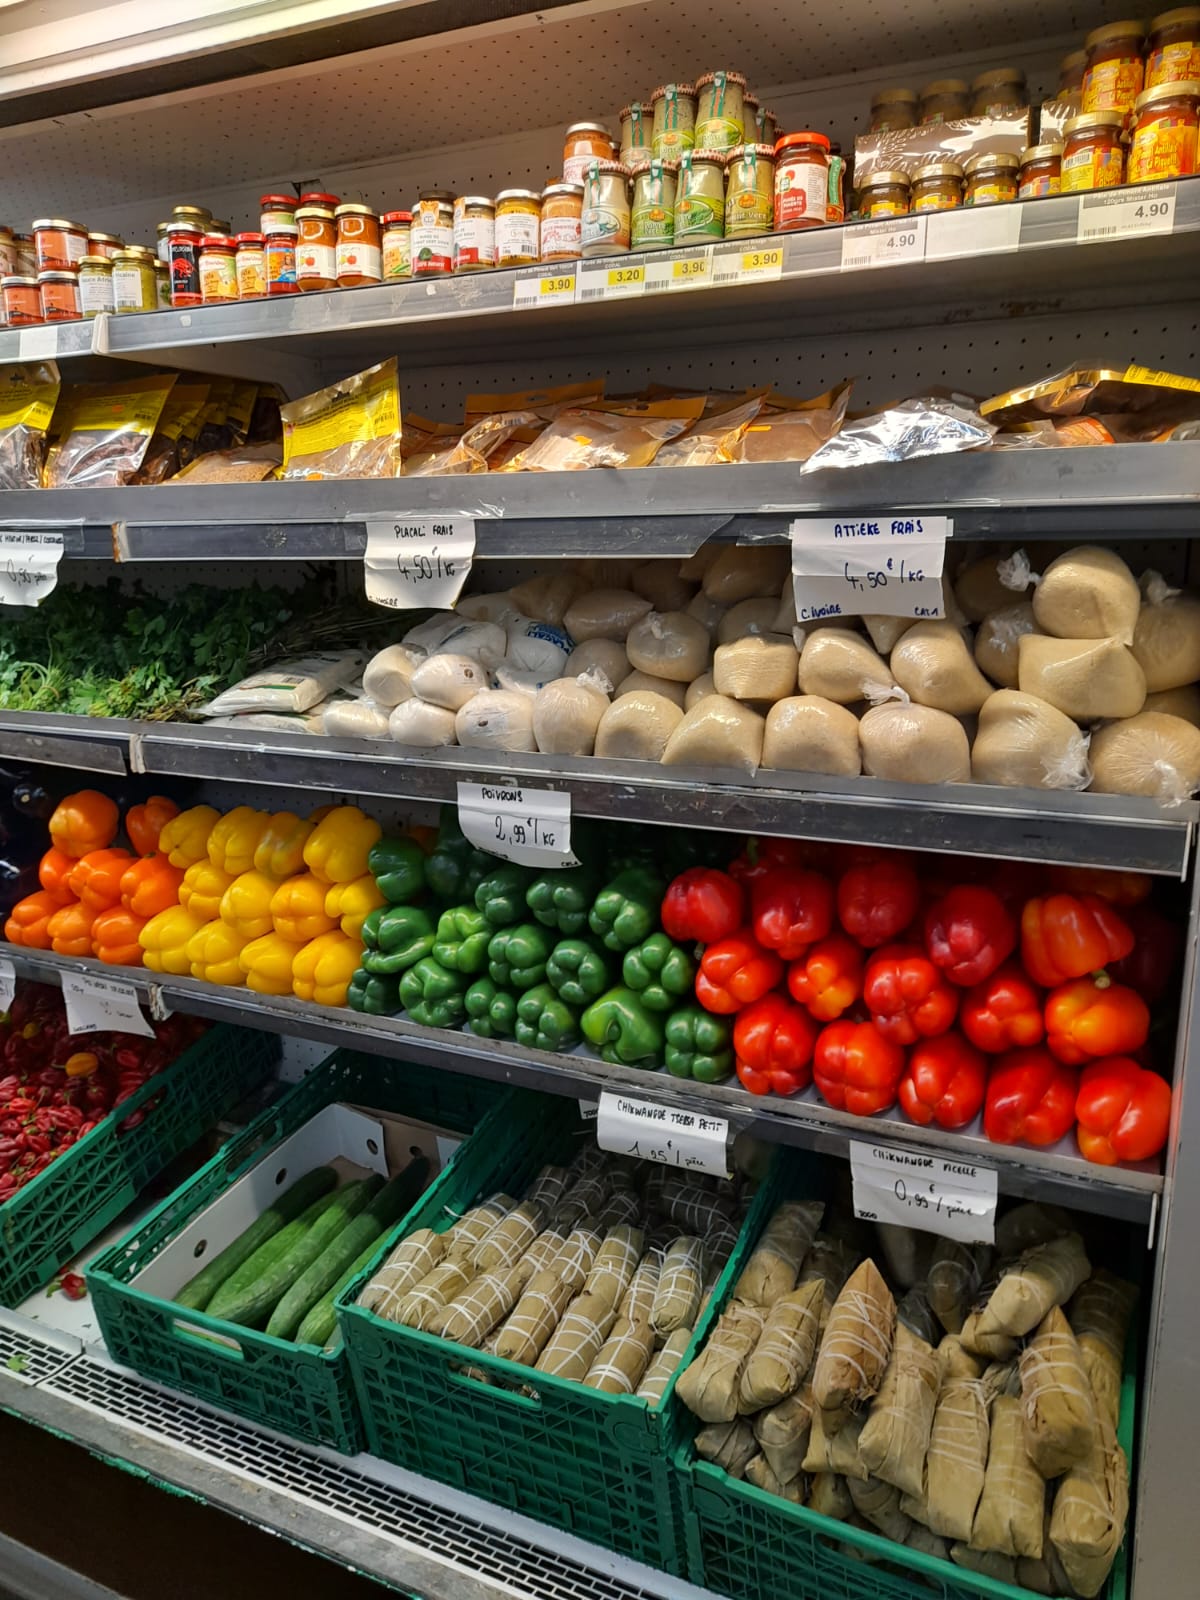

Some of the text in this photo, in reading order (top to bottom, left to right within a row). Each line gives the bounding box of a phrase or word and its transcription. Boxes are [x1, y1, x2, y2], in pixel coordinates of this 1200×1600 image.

[1134, 202, 1169, 218] 4.90
[886, 233, 916, 248] 4.90
[752, 252, 778, 266] 3.90
[682, 261, 705, 274] 3.90
[616, 269, 640, 282] 3.20
[548, 279, 571, 291] 3.90
